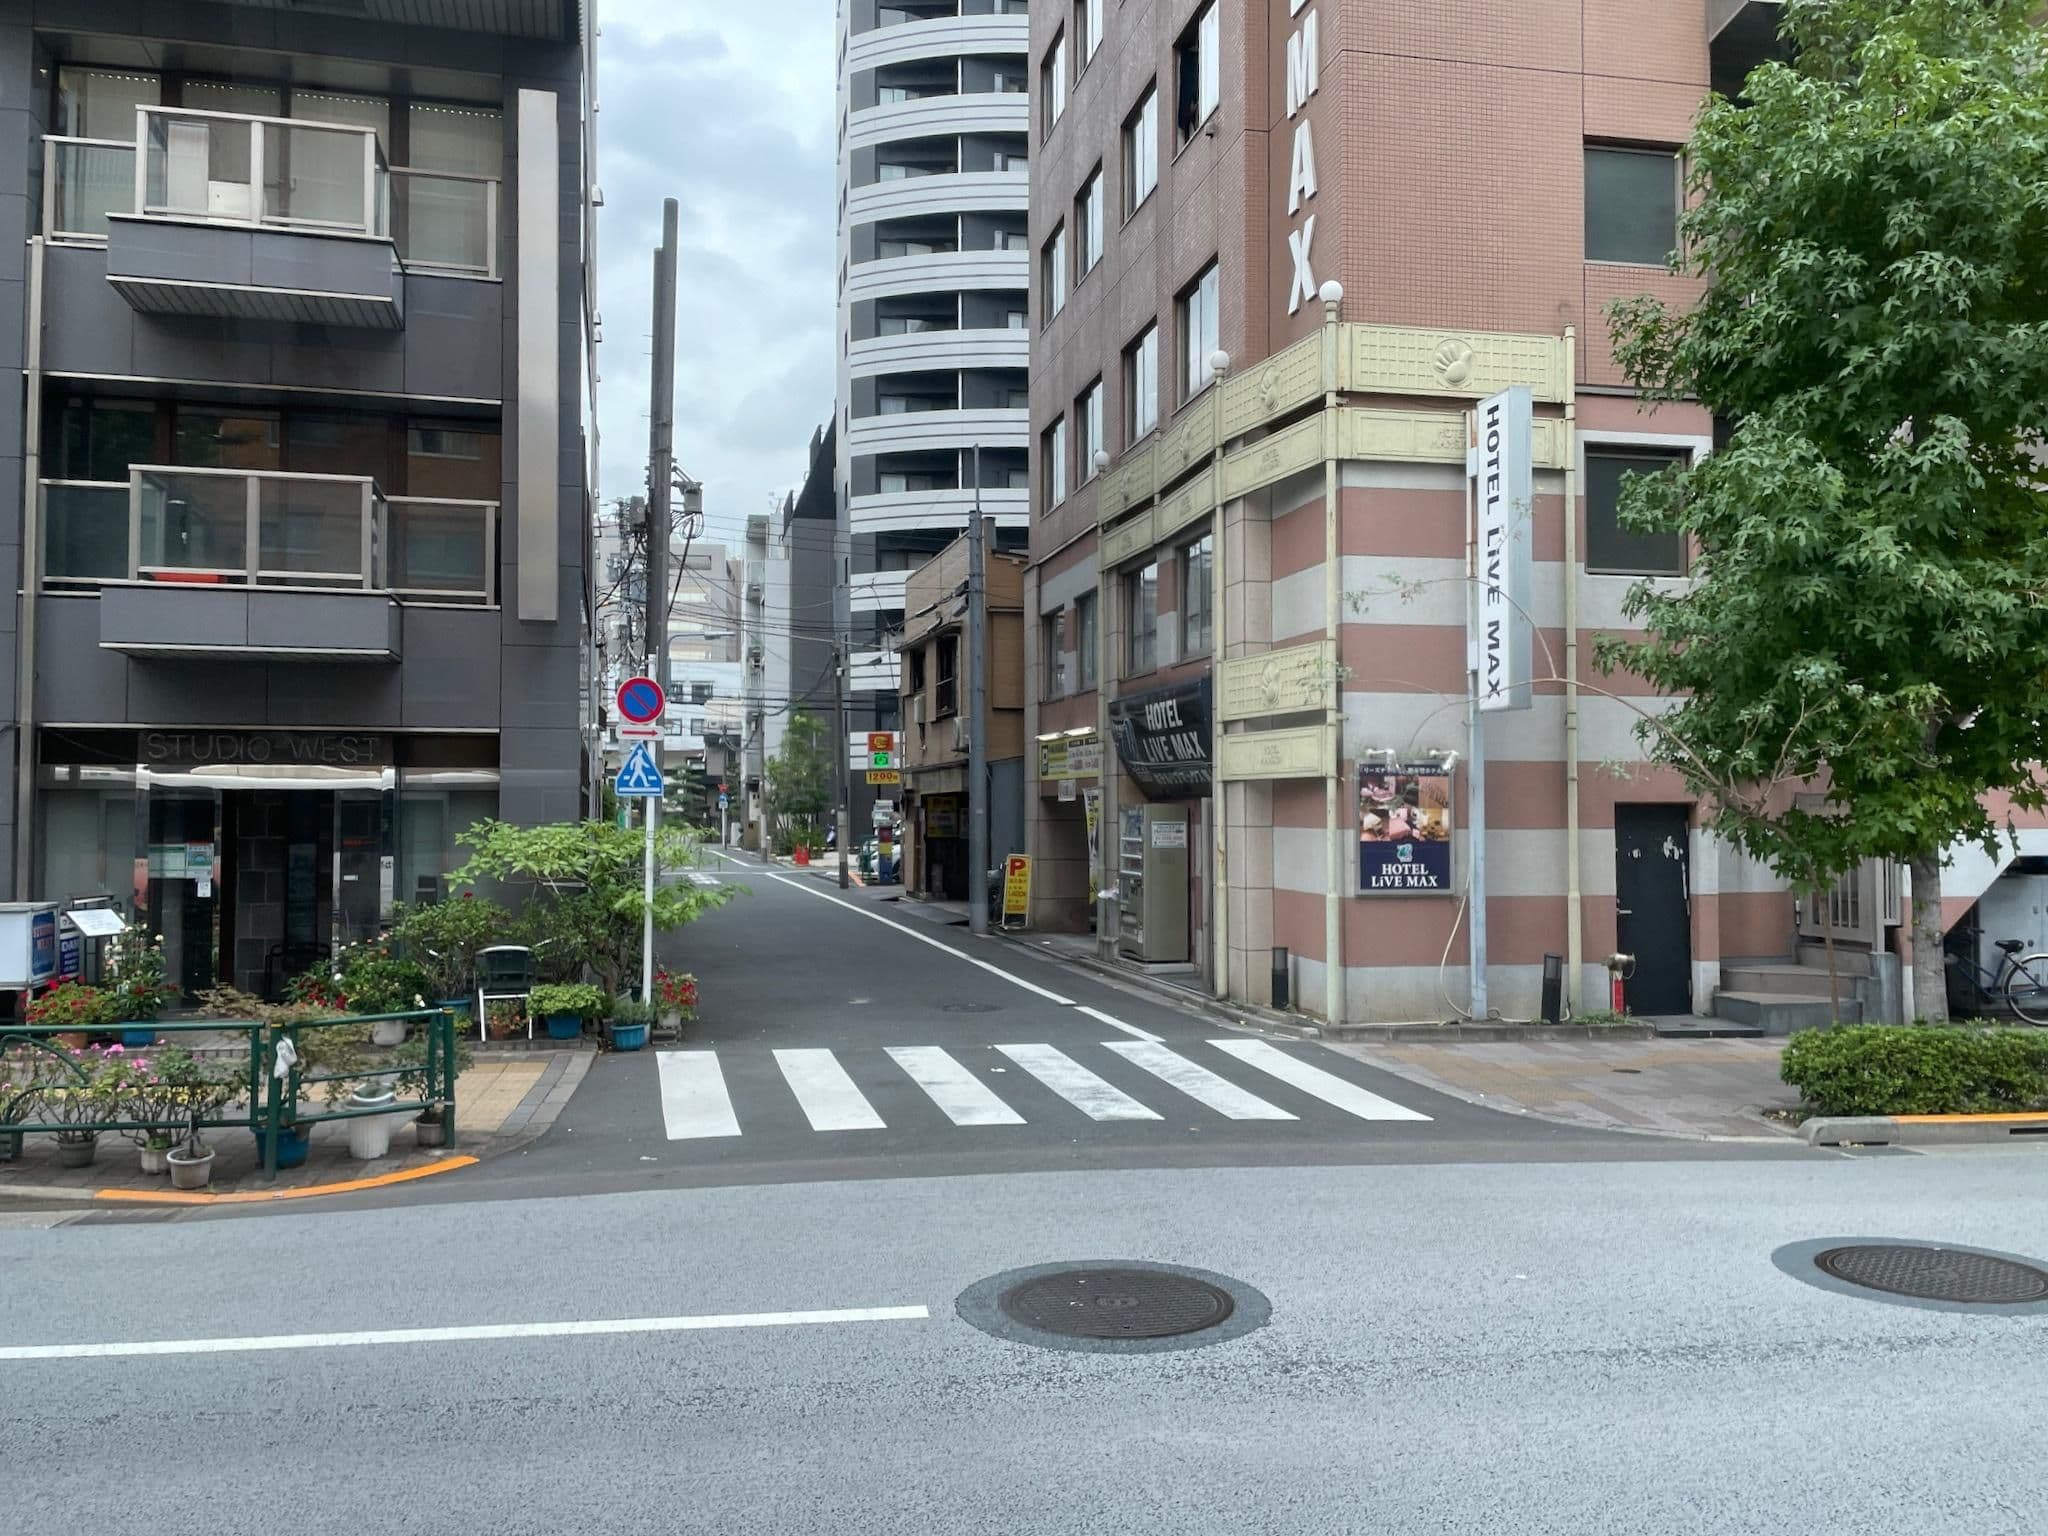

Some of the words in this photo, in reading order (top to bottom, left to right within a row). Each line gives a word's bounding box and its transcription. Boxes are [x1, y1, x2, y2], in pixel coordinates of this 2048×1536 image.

[1287, 8, 1319, 316] MAX
[1486, 403, 1500, 515] HOTEL
[1486, 619, 1500, 698] MAX
[1145, 698, 1184, 731] HOTEL
[146, 733, 271, 761] STUDIO
[287, 735, 380, 762] WEST
[1170, 730, 1207, 760] MAX
[1009, 858, 1026, 877] P
[1381, 863, 1429, 875] HOTEL
[1406, 876, 1438, 887] MAX
